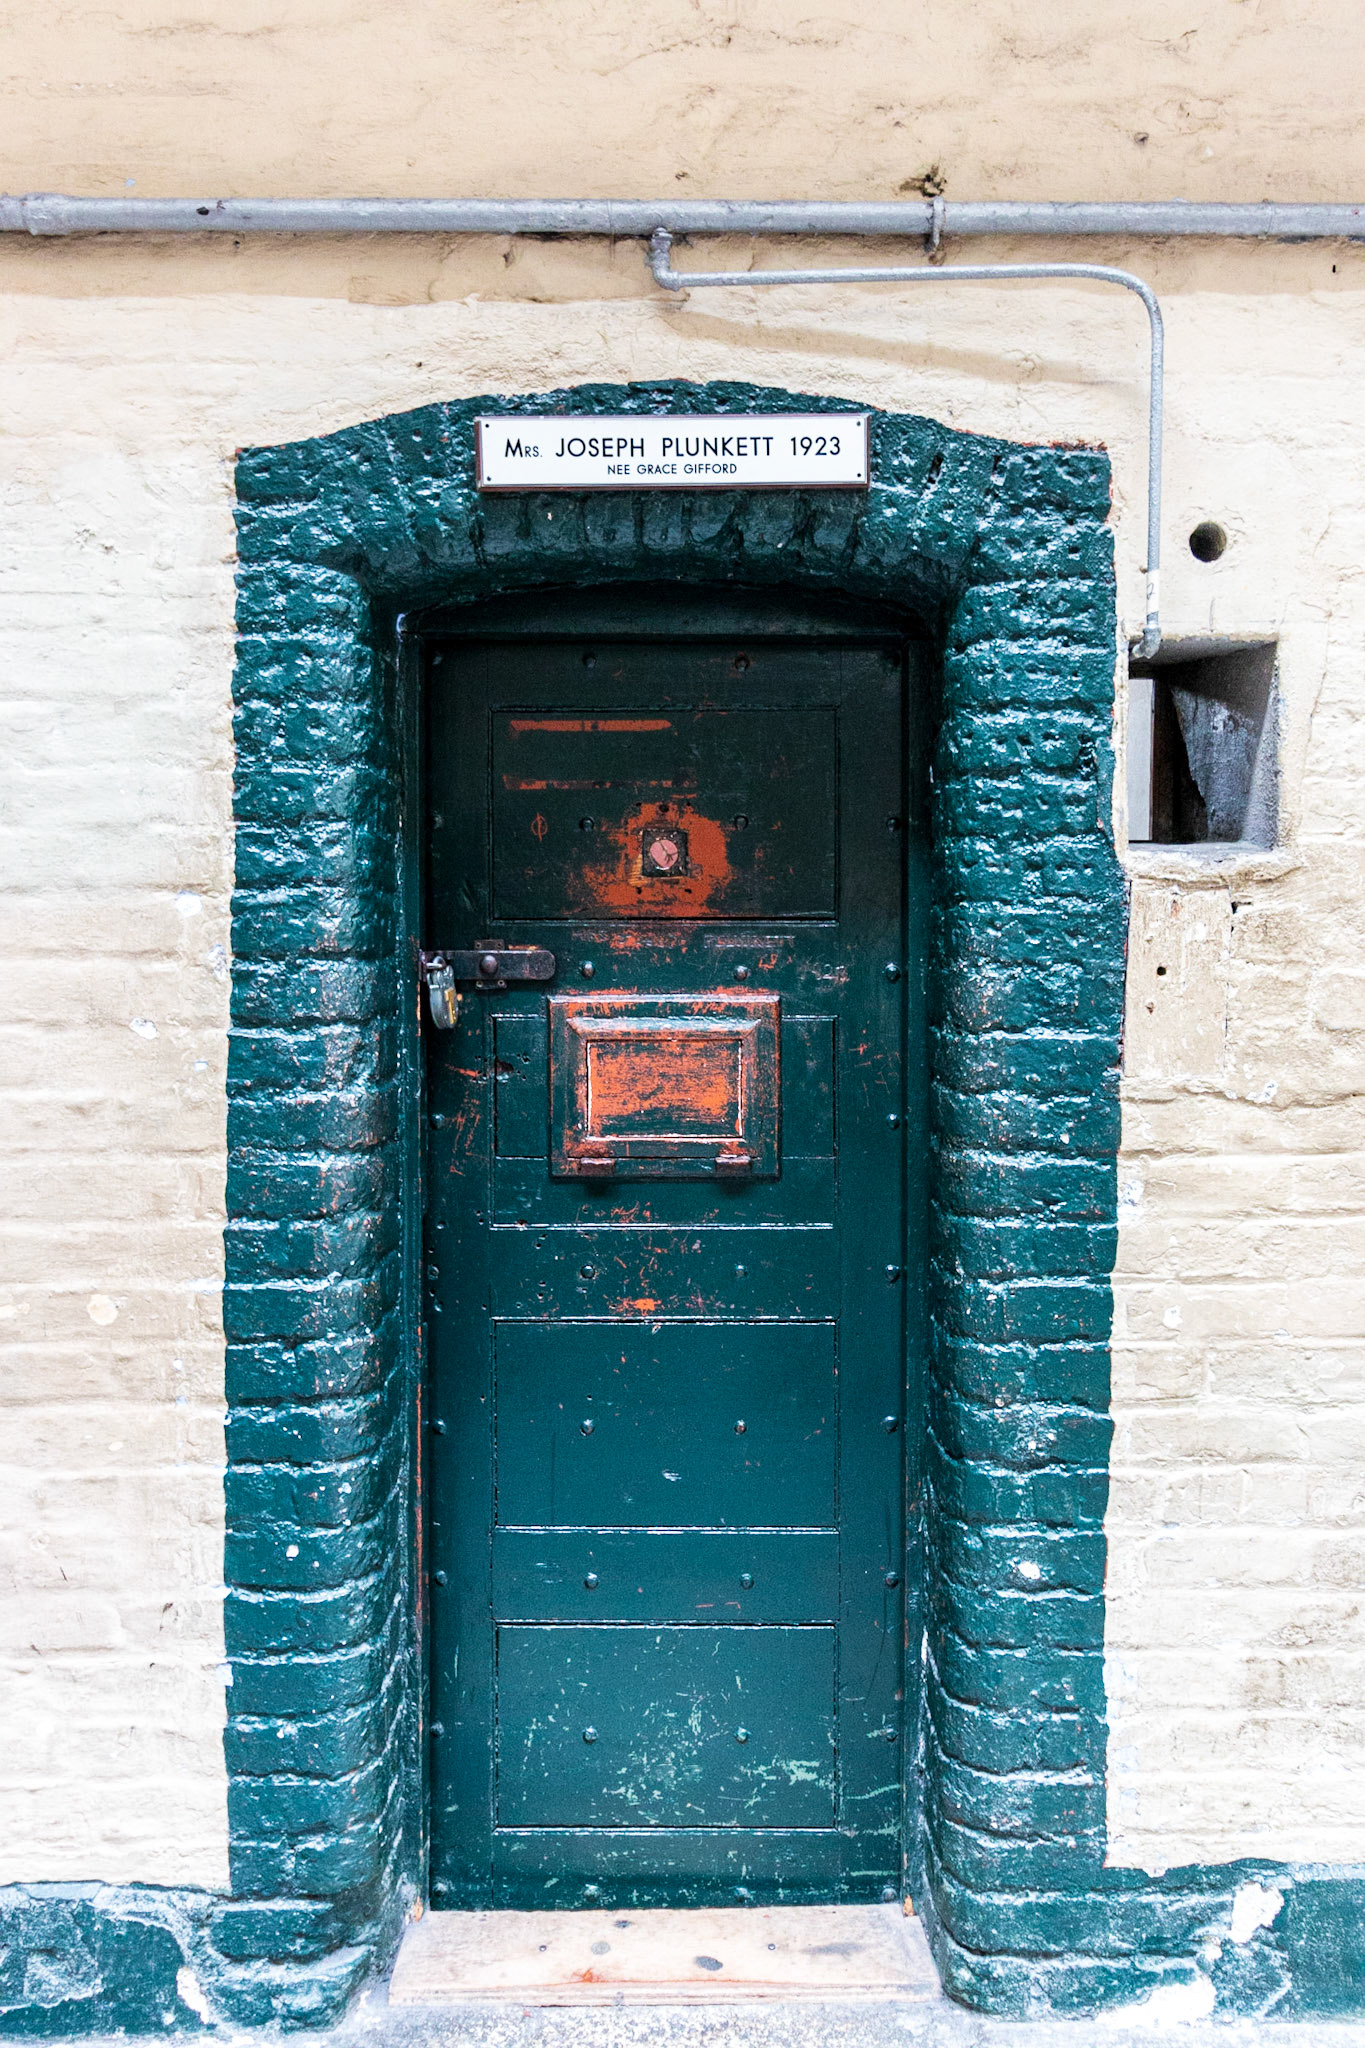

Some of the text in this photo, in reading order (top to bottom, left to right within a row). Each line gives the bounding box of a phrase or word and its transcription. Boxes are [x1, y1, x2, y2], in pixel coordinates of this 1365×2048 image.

[555, 437, 645, 458] JOSEPH
[662, 436, 774, 457] PLUNKETT
[790, 436, 841, 456] 1923
[607, 463, 737, 475] NEE GRACE GIFFORD
